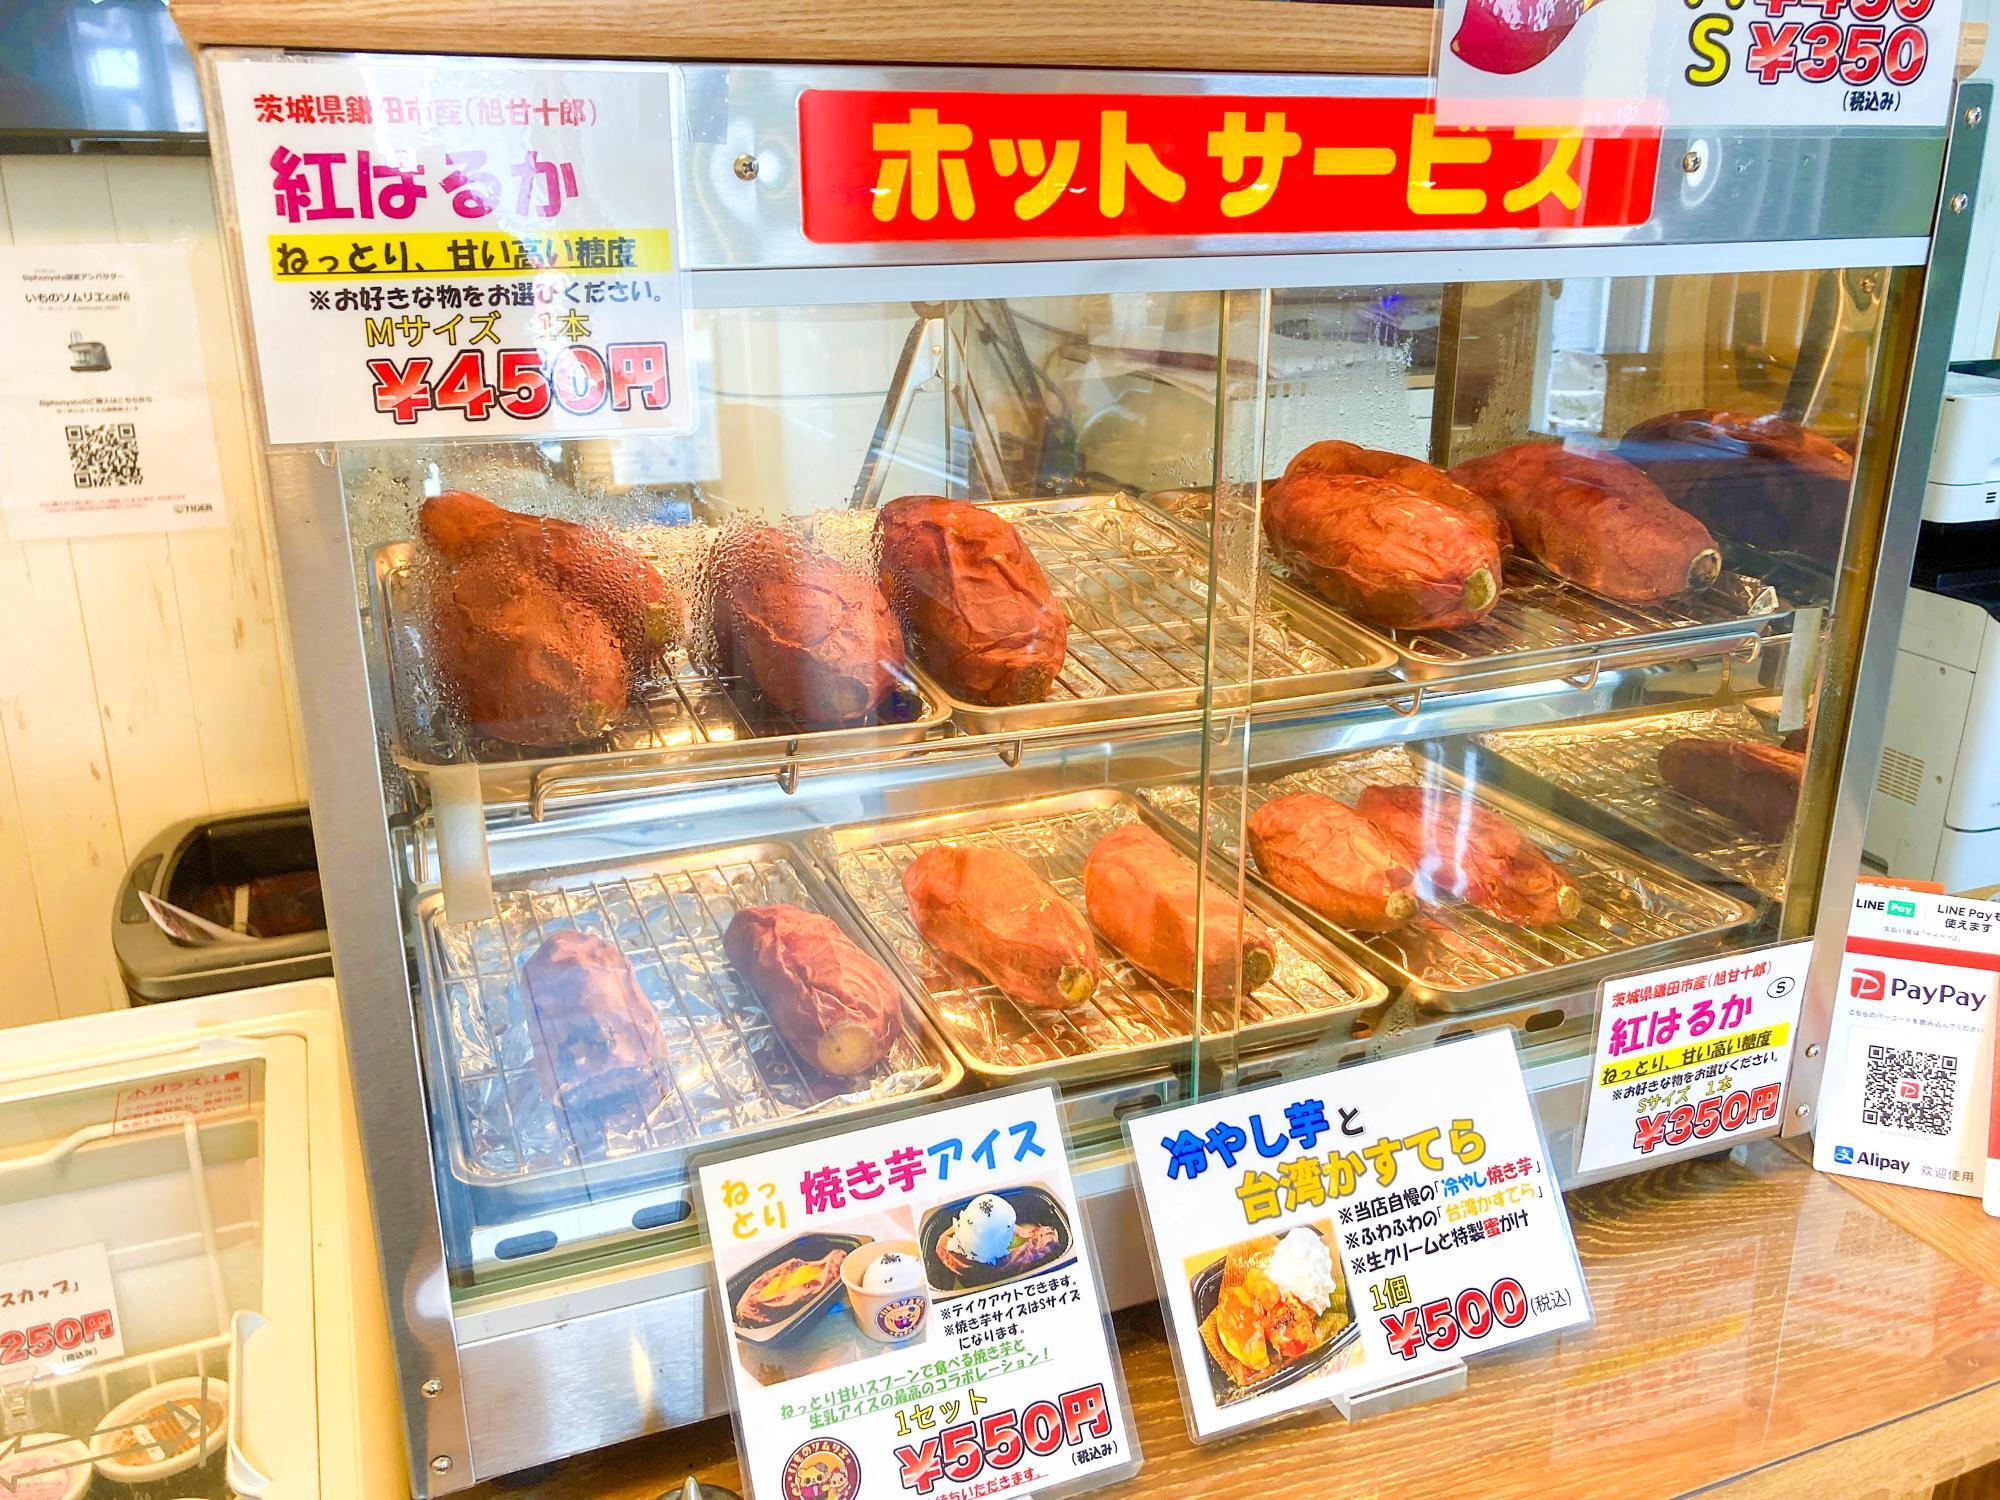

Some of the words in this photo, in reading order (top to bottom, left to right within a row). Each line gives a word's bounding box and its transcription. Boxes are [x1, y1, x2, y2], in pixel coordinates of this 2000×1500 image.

[1685, 13, 1734, 87] S
[1746, 21, 1929, 86] ¥350
[1841, 90, 1901, 112] (税込み)
[270, 145, 579, 223] 紅はるか
[871, 108, 1585, 221] ホットサービス
[365, 312, 502, 348] Mサイズ
[366, 340, 672, 425] ¥450円
[1855, 898, 1886, 911] LINE
[1890, 903, 1913, 916] Pay
[1937, 904, 1966, 917] LINE
[1944, 918, 1993, 933] 使えます
[1891, 977, 1987, 1012] PayPay
[1608, 993, 1753, 1057] 紅はるか
[1633, 1082, 1782, 1154] ¥350円
[1637, 1085, 1692, 1114] Sサイズ
[1160, 1098, 1365, 1181] 冷やし芋と
[799, 1120, 1047, 1215] 焼き芋アイス
[1235, 1118, 1487, 1225] 台湾かすてら
[1856, 1151, 1910, 1174] Alipay
[1921, 1165, 1975, 1183] 欢迎使用
[1369, 1274, 1412, 1312] 1個
[958, 1323, 1025, 1350] になります。
[1380, 1277, 1530, 1361] ¥500
[1529, 1287, 1572, 1317] (税込)
[894, 1388, 987, 1436] 1セット
[894, 1382, 1111, 1494] ¥550円
[1071, 1440, 1119, 1466] (税込み)
